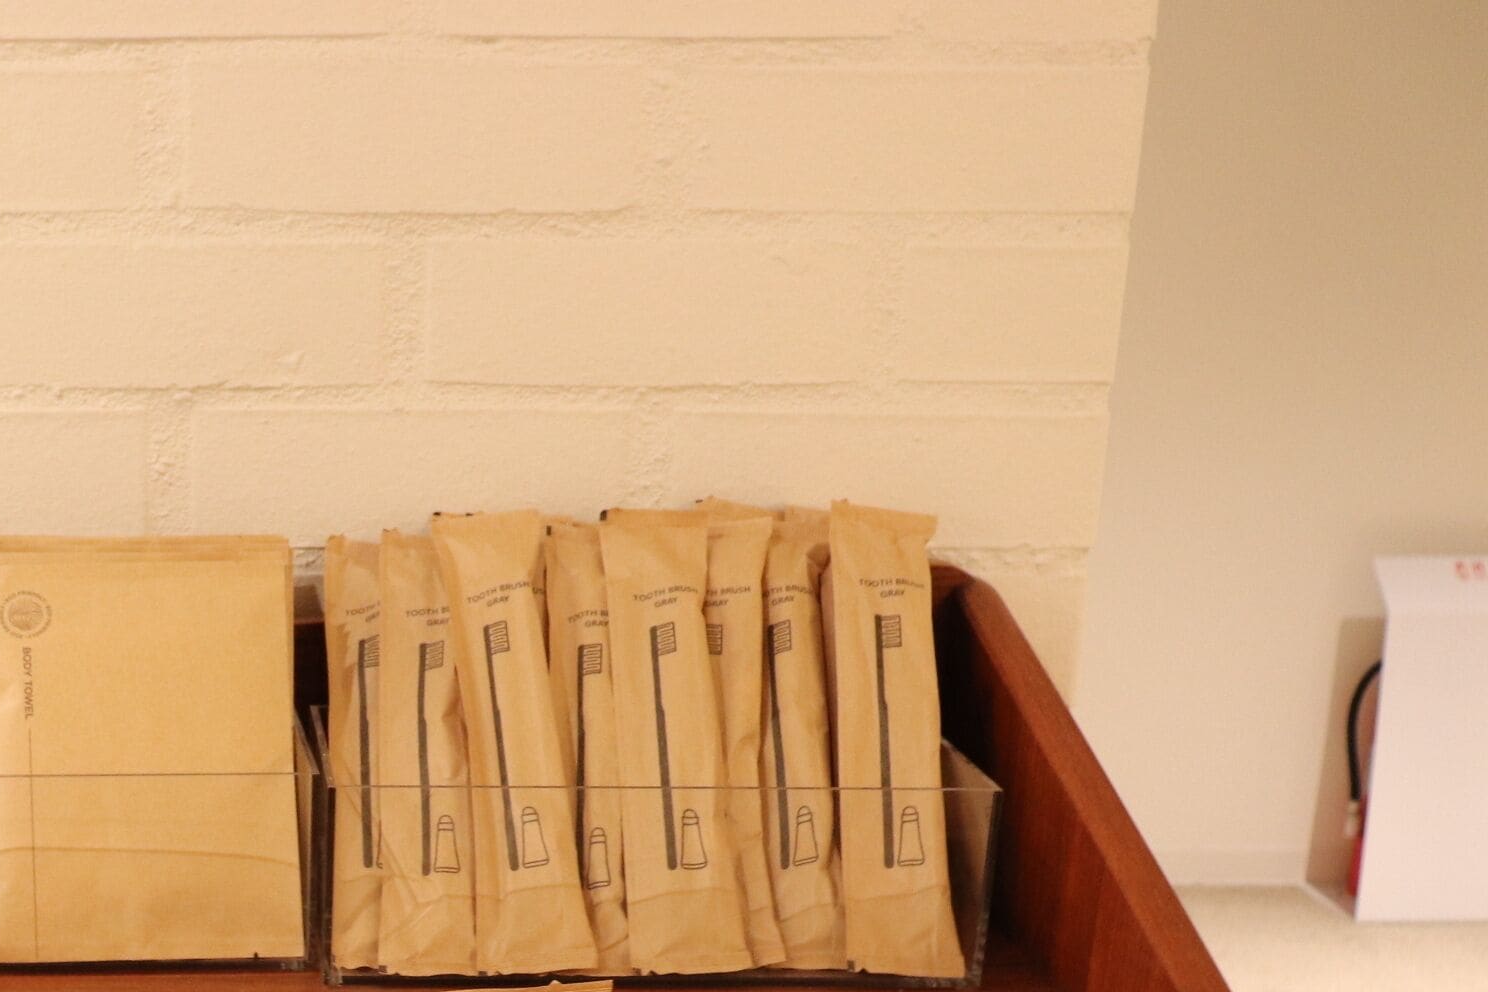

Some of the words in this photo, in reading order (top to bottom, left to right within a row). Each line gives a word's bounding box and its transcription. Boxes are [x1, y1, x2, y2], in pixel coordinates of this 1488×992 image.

[860, 578, 892, 588] TOOTH
[467, 588, 497, 604] TOOTH
[499, 581, 530, 593] BRUSH
[633, 589, 666, 601] TOOTH
[720, 585, 751, 595] BRUSH
[880, 589, 905, 599] GRAY
[486, 595, 510, 608] GRAY
[654, 597, 678, 608] GRAY
[771, 595, 795, 607] GRAY
[22, 646, 33, 678] BODY
[23, 680, 34, 720] TOWEL
